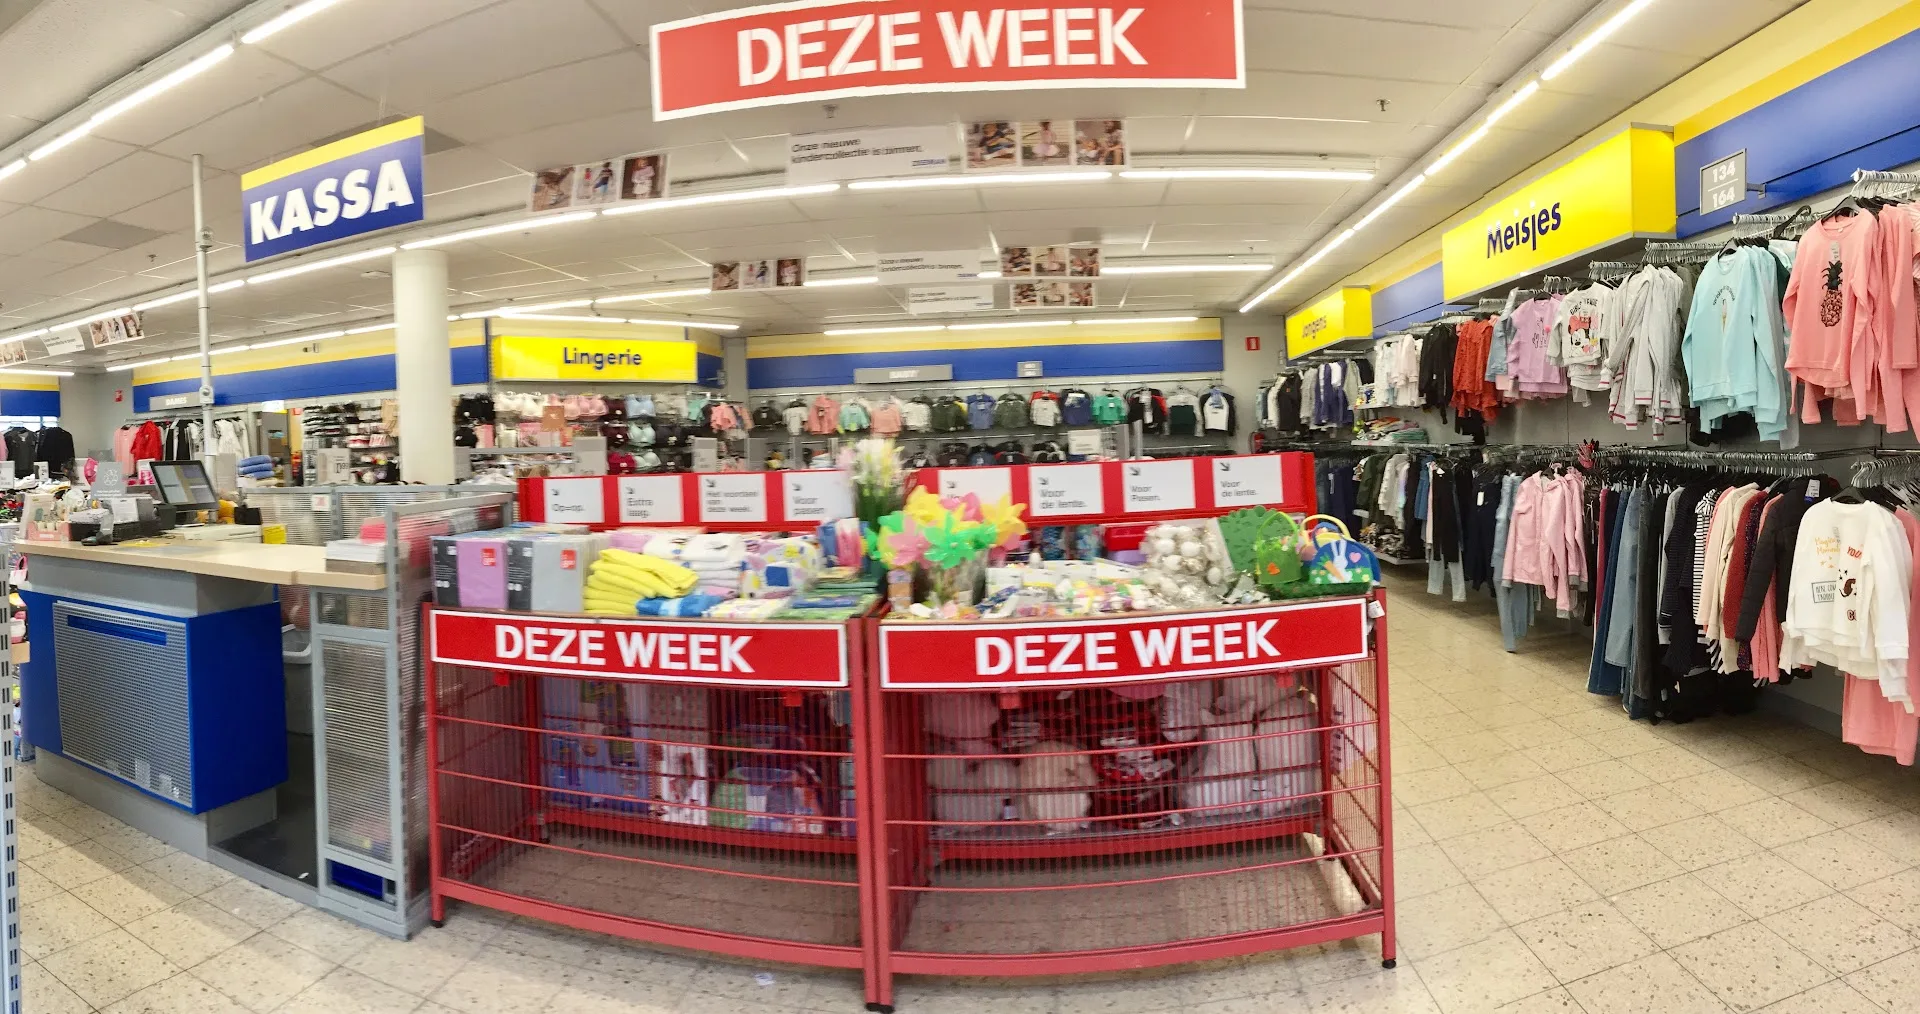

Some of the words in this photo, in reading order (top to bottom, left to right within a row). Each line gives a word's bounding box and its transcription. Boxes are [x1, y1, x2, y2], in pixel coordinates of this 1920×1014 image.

[737, 11, 923, 86] DEZE
[935, 7, 1149, 69] WEEK
[1712, 160, 1736, 183] 134
[250, 159, 414, 245] KASSA
[1712, 186, 1736, 208] 164
[1487, 201, 1561, 259] Meisjes
[563, 347, 642, 371] Lingerie
[1220, 480, 1240, 488] Voor
[495, 624, 606, 666] DEZE
[615, 631, 755, 673] WEEK
[975, 631, 1118, 676] DEZE
[1129, 619, 1282, 668] WEEK
